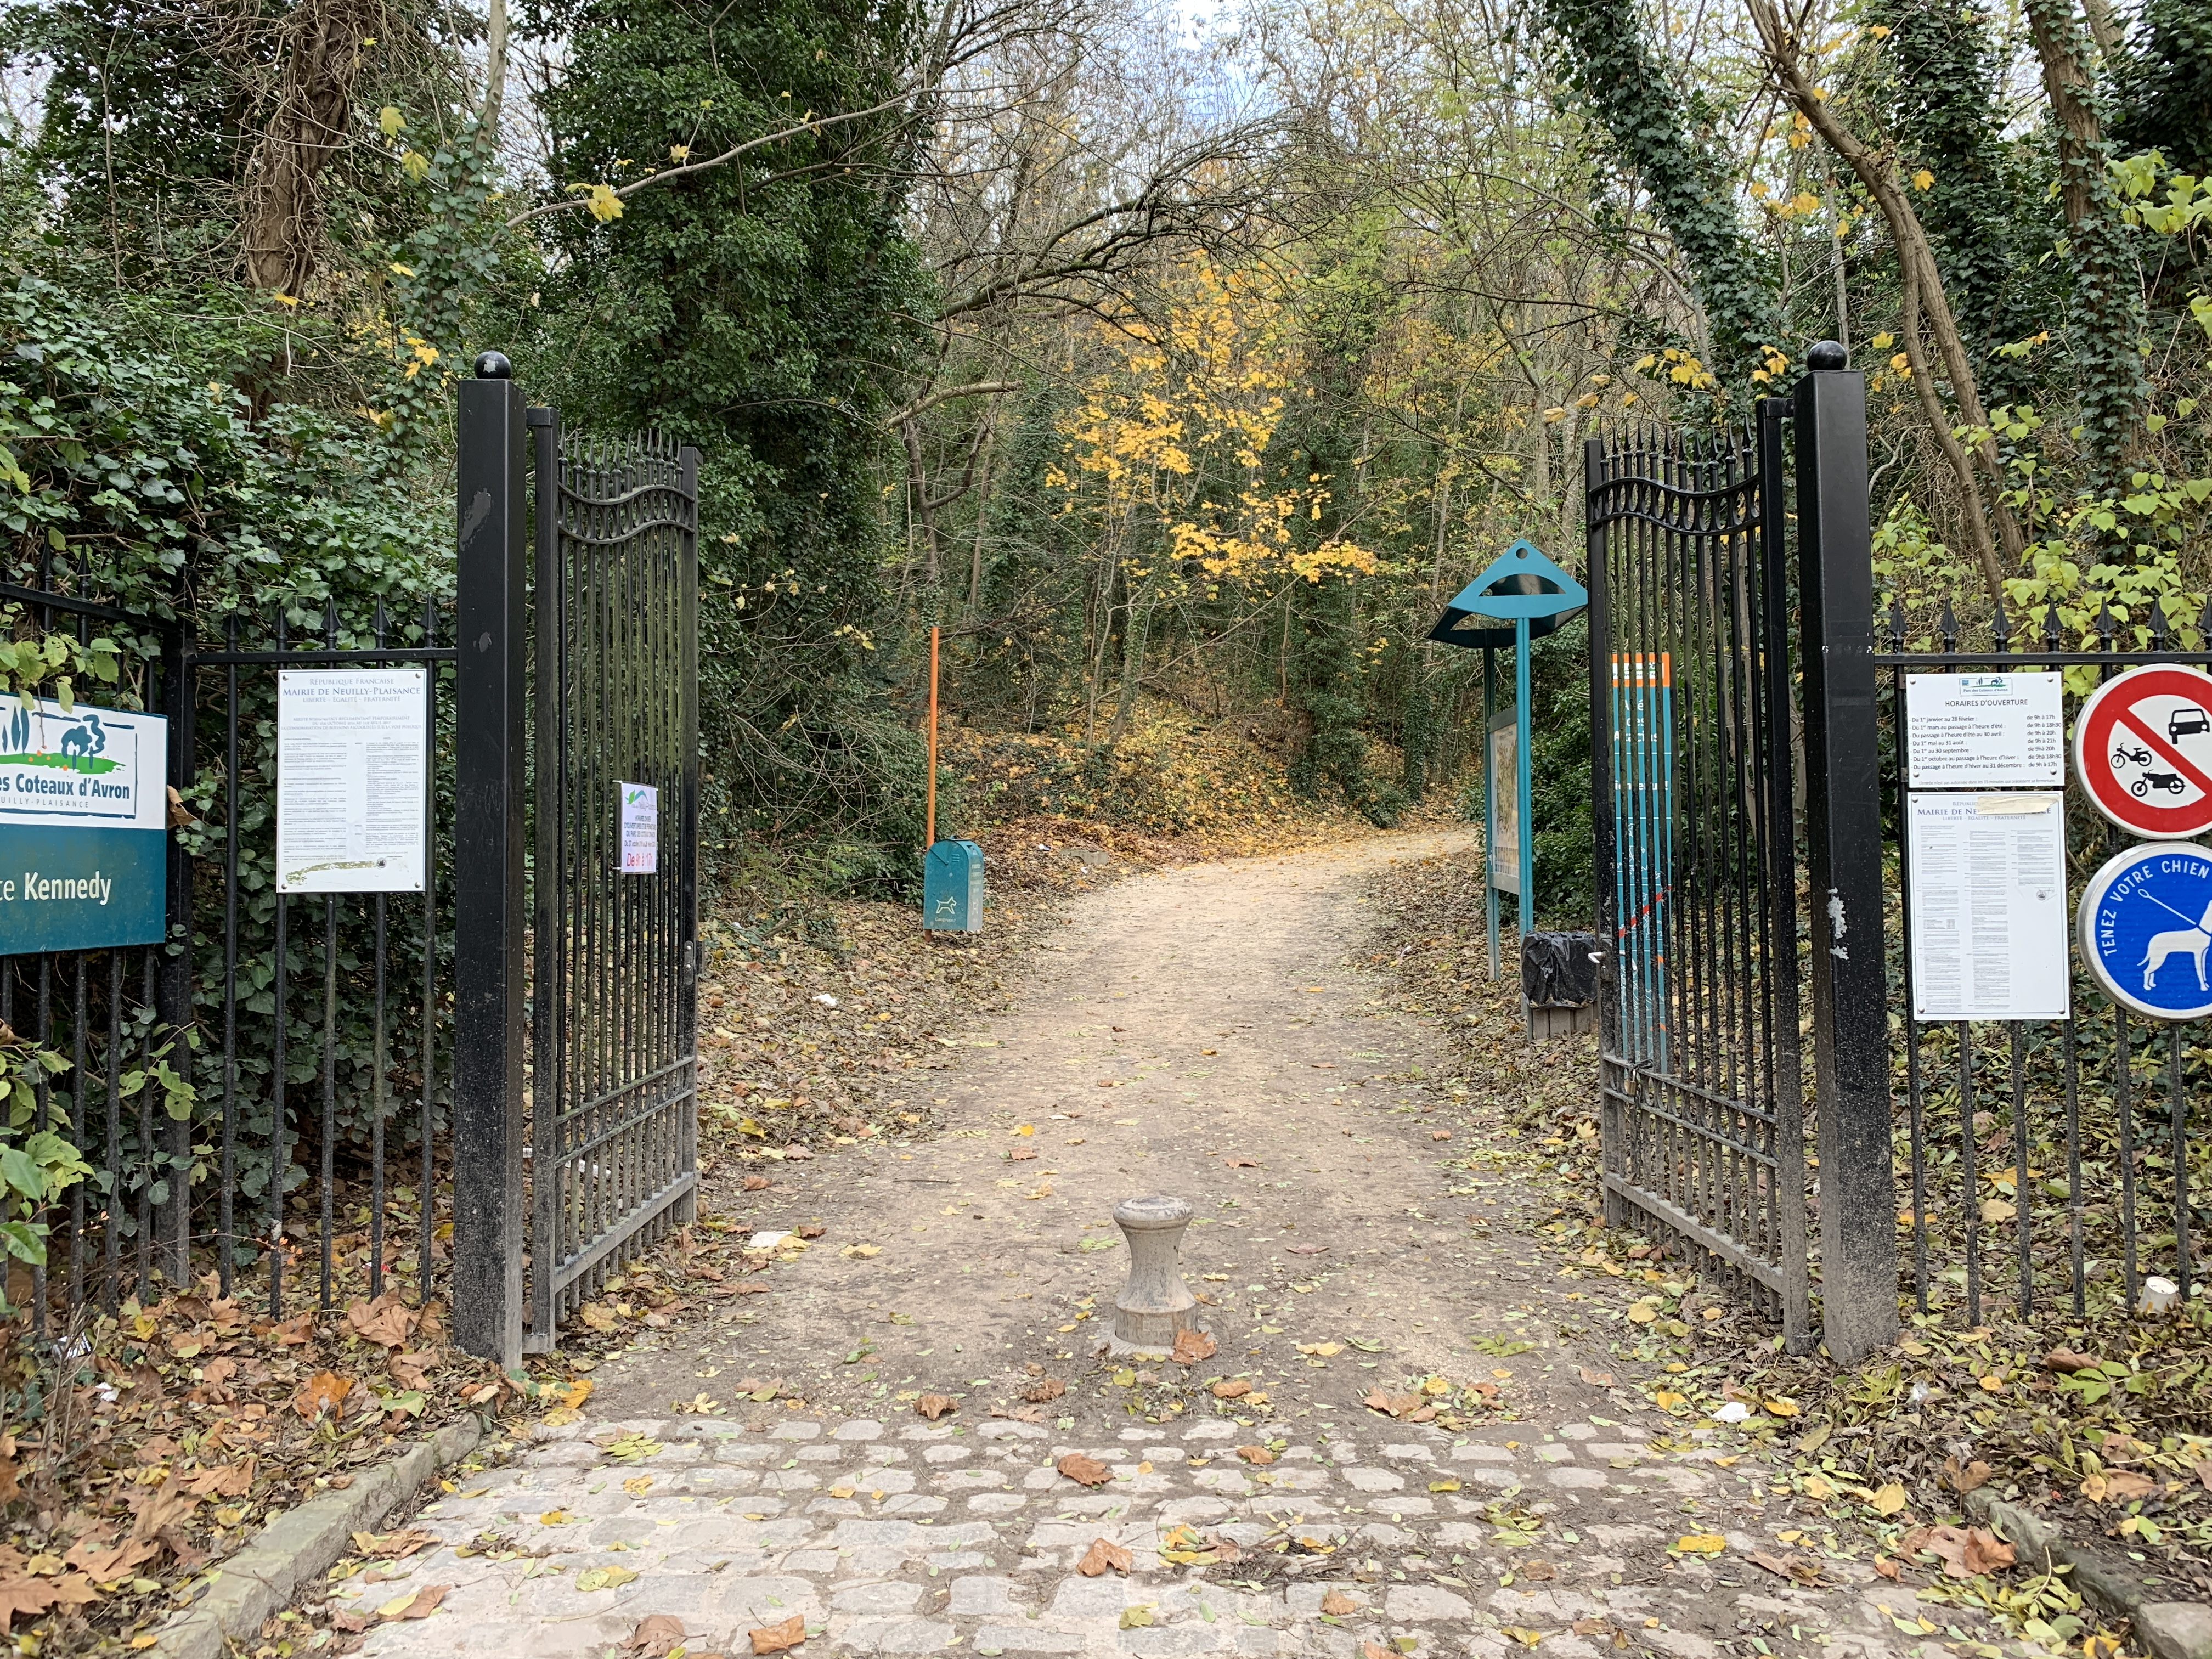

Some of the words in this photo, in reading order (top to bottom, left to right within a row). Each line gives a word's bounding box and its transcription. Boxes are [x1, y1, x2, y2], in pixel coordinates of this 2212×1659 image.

[16, 773, 74, 795] Coteaux
[79, 777, 129, 799] d'Avron
[627, 853, 635, 866] De
[2162, 860, 2210, 879] CHIEN
[24, 871, 112, 906] Kennedy
[2109, 865, 2154, 902] VOTRE
[2101, 909, 2118, 957] TENEZ
